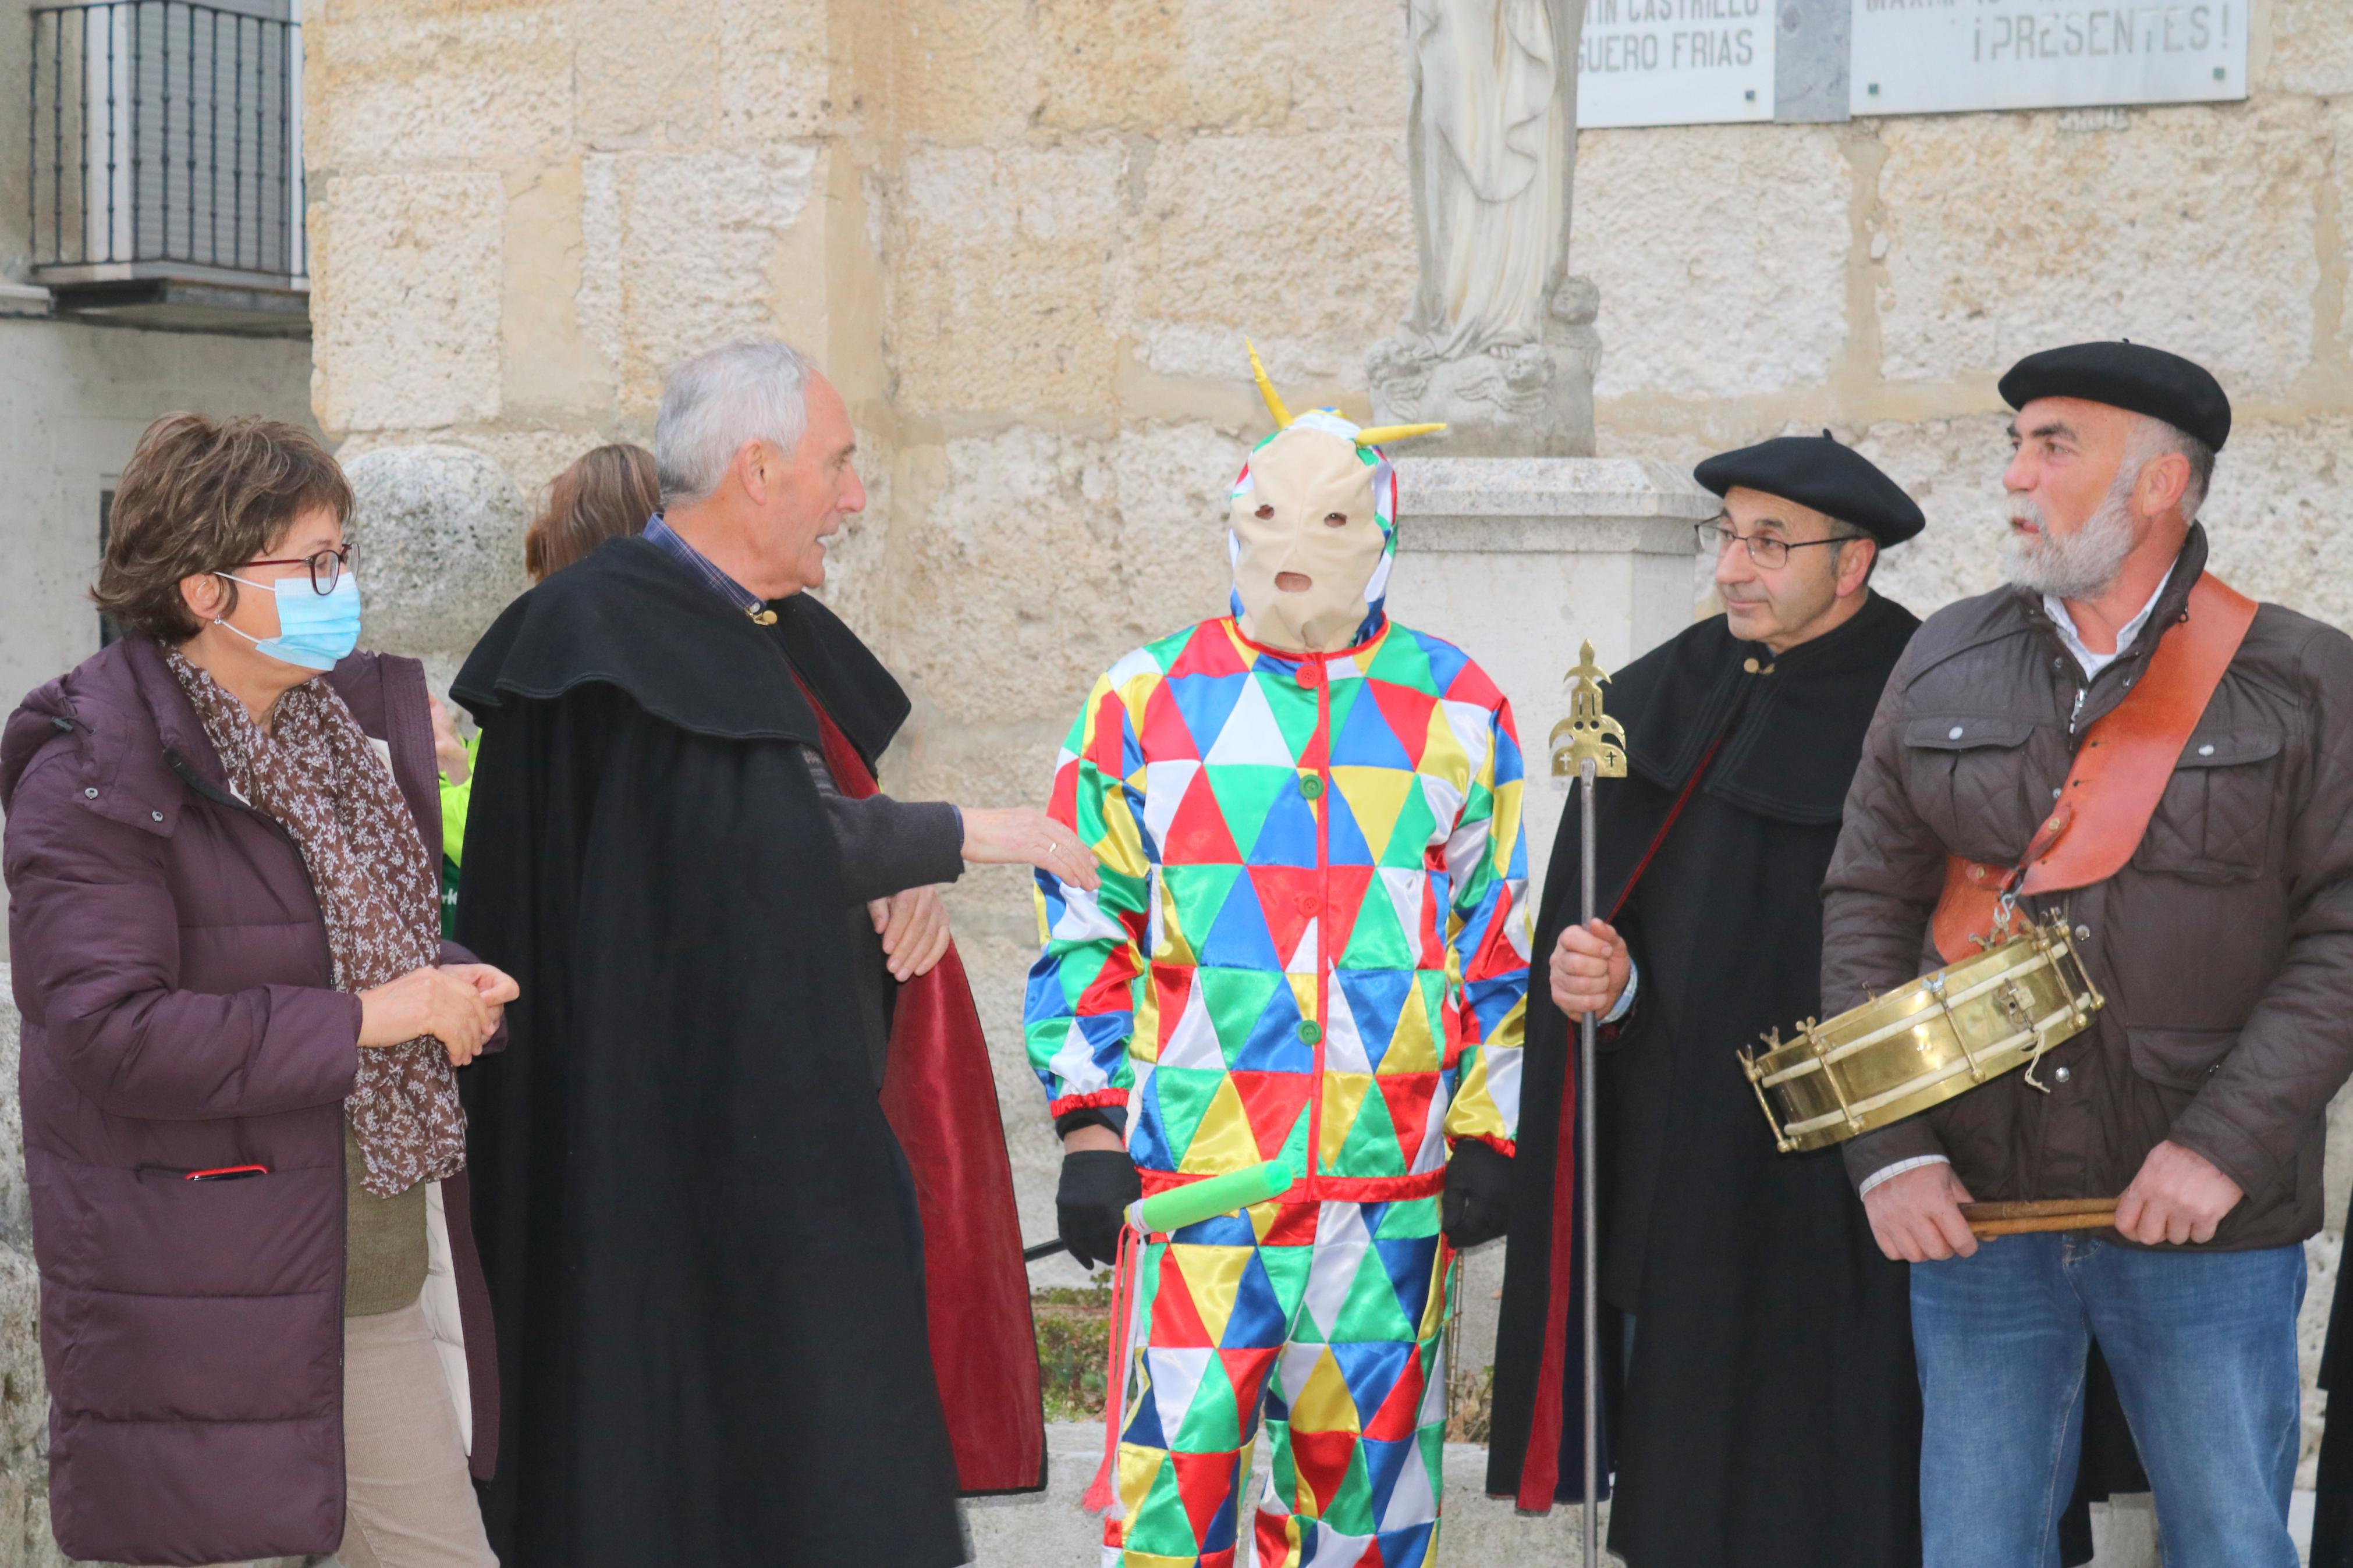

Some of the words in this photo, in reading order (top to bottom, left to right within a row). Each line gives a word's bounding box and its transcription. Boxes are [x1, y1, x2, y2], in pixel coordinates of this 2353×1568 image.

[1628, 0, 1758, 22] CASTRILLO
[1671, 28, 1752, 69] FRIAS
[1974, 3, 2229, 62] ¡PRESENTES!
